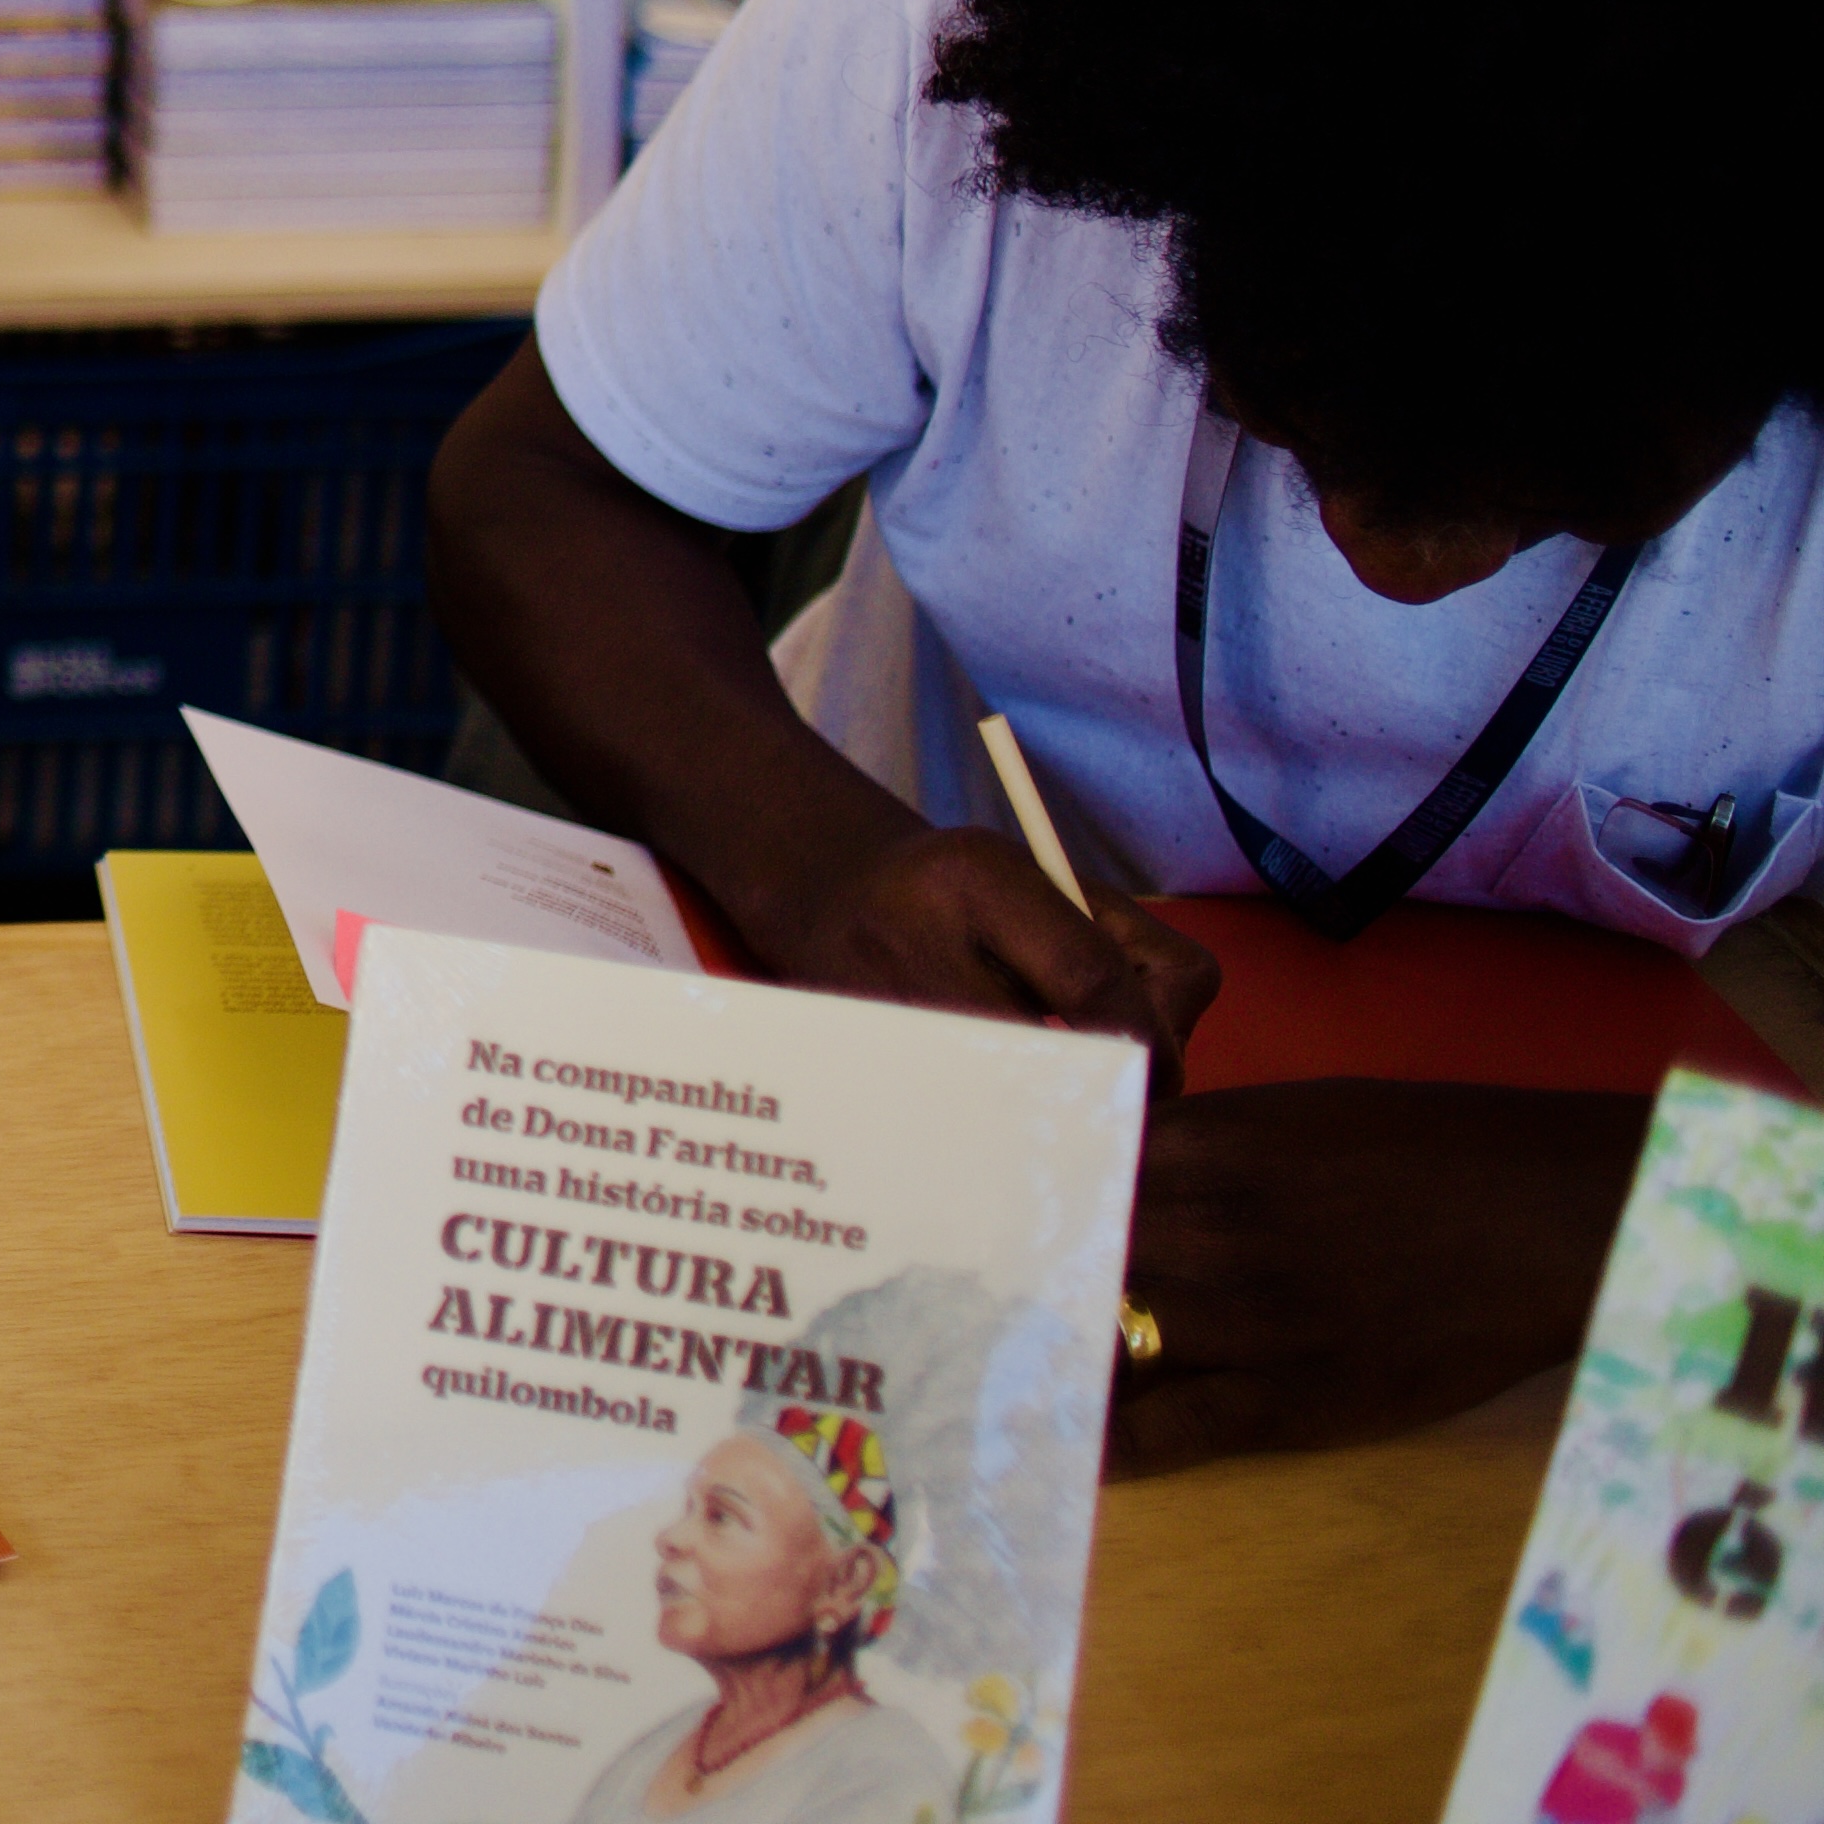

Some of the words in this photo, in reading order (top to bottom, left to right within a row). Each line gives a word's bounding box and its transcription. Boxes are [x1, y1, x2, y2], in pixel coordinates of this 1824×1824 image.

[1558, 595, 1608, 636] FEIRA
[1525, 644, 1577, 688] LIVRO
[466, 1038, 523, 1078] Na
[531, 1056, 781, 1123] companhia
[460, 1097, 514, 1133] de
[522, 1104, 638, 1154] Dona
[645, 1125, 827, 1193] Fartura,
[451, 1154, 548, 1196] uma
[556, 1168, 730, 1229] história
[739, 1206, 867, 1252] sobre
[440, 1212, 792, 1321] CULTURA
[427, 1284, 887, 1414] ALIMENTAR
[420, 1362, 677, 1434] quilombola
